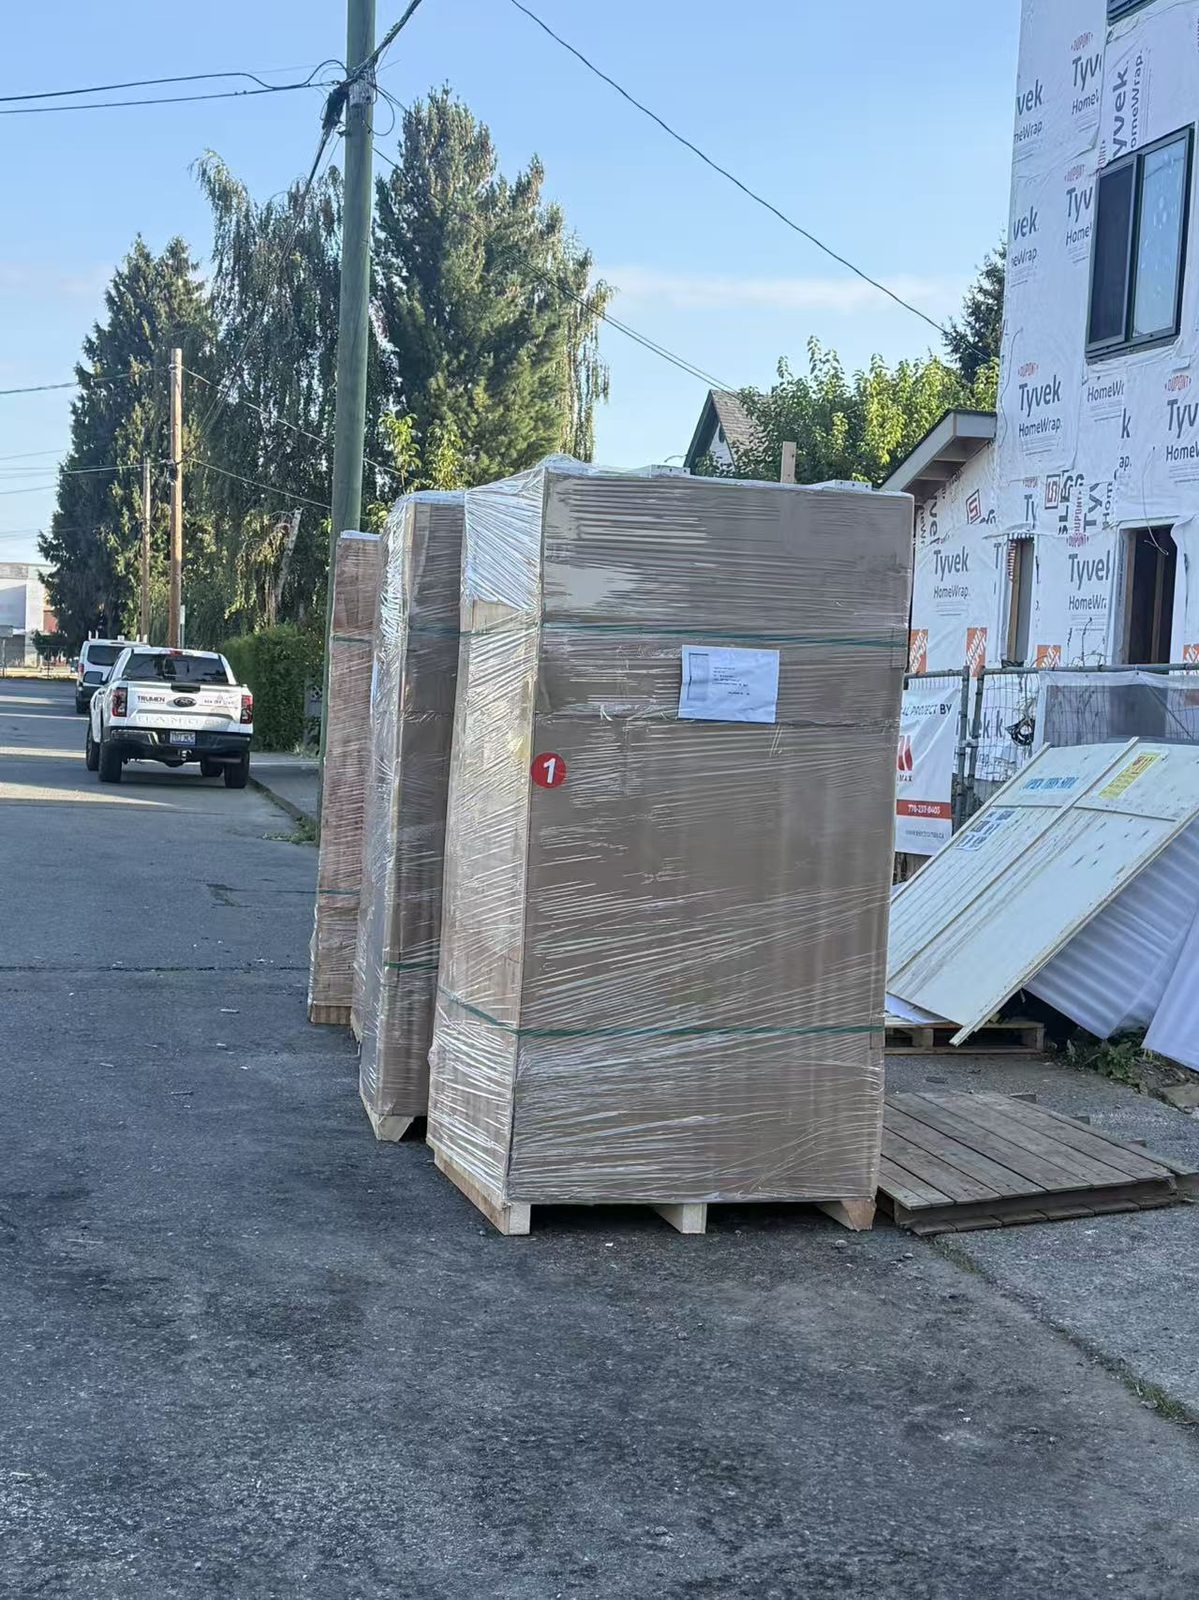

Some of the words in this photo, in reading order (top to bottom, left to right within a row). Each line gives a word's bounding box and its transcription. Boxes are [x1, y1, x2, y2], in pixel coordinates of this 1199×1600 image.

[1019, 374, 1061, 418] Tyvek
[1018, 417, 1061, 438] HomeWrap
[933, 546, 969, 581] Tyvek
[933, 585, 969, 599] HomeWrap
[940, 703, 952, 715] BY
[543, 757, 556, 784] 1
